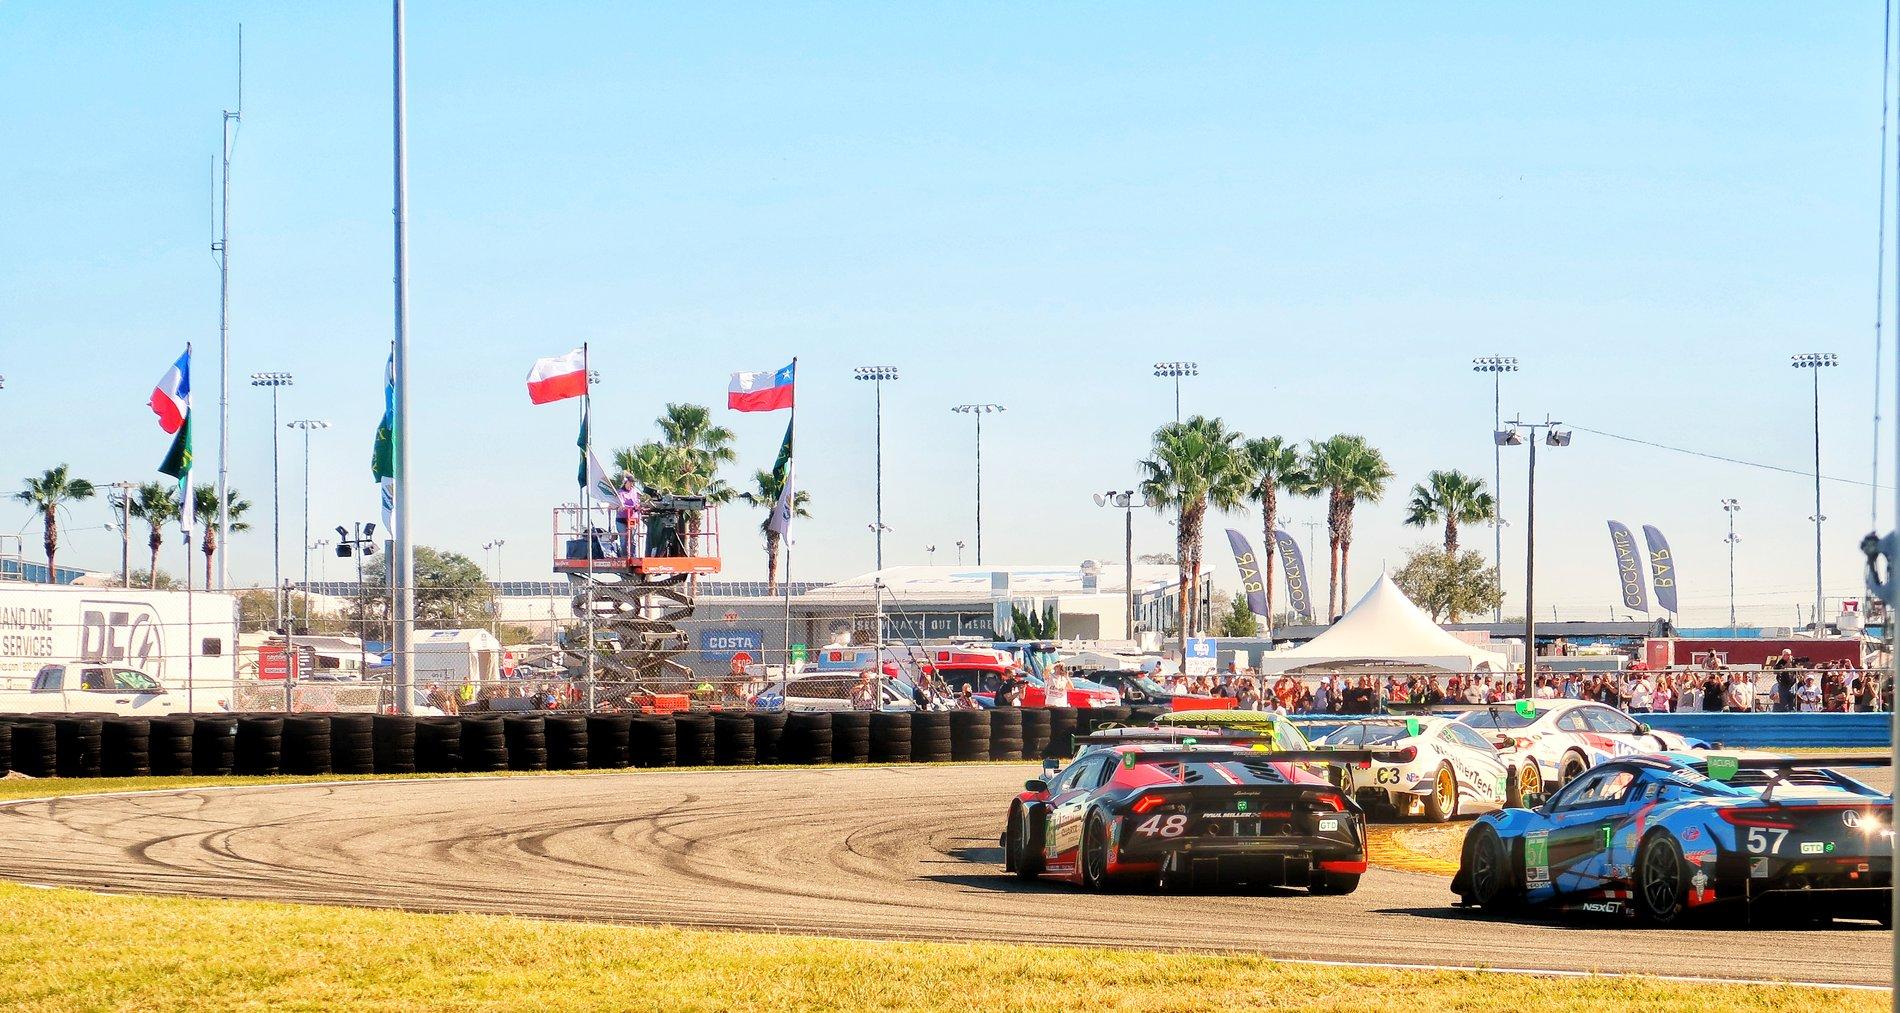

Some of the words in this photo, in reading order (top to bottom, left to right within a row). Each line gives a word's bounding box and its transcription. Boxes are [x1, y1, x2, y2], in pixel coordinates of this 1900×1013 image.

[29, 608, 53, 631] ONE
[931, 619, 952, 631] OUT
[2, 636, 53, 657] SERVICES
[709, 637, 753, 649] COSTA
[1713, 759, 1736, 768] ACURA
[1376, 767, 1401, 784] 63
[1135, 814, 1189, 838] 48
[1320, 821, 1337, 829] GTD
[1746, 826, 1789, 854] 57
[1802, 843, 1823, 852] GTD
[1526, 838, 1547, 866] 57
